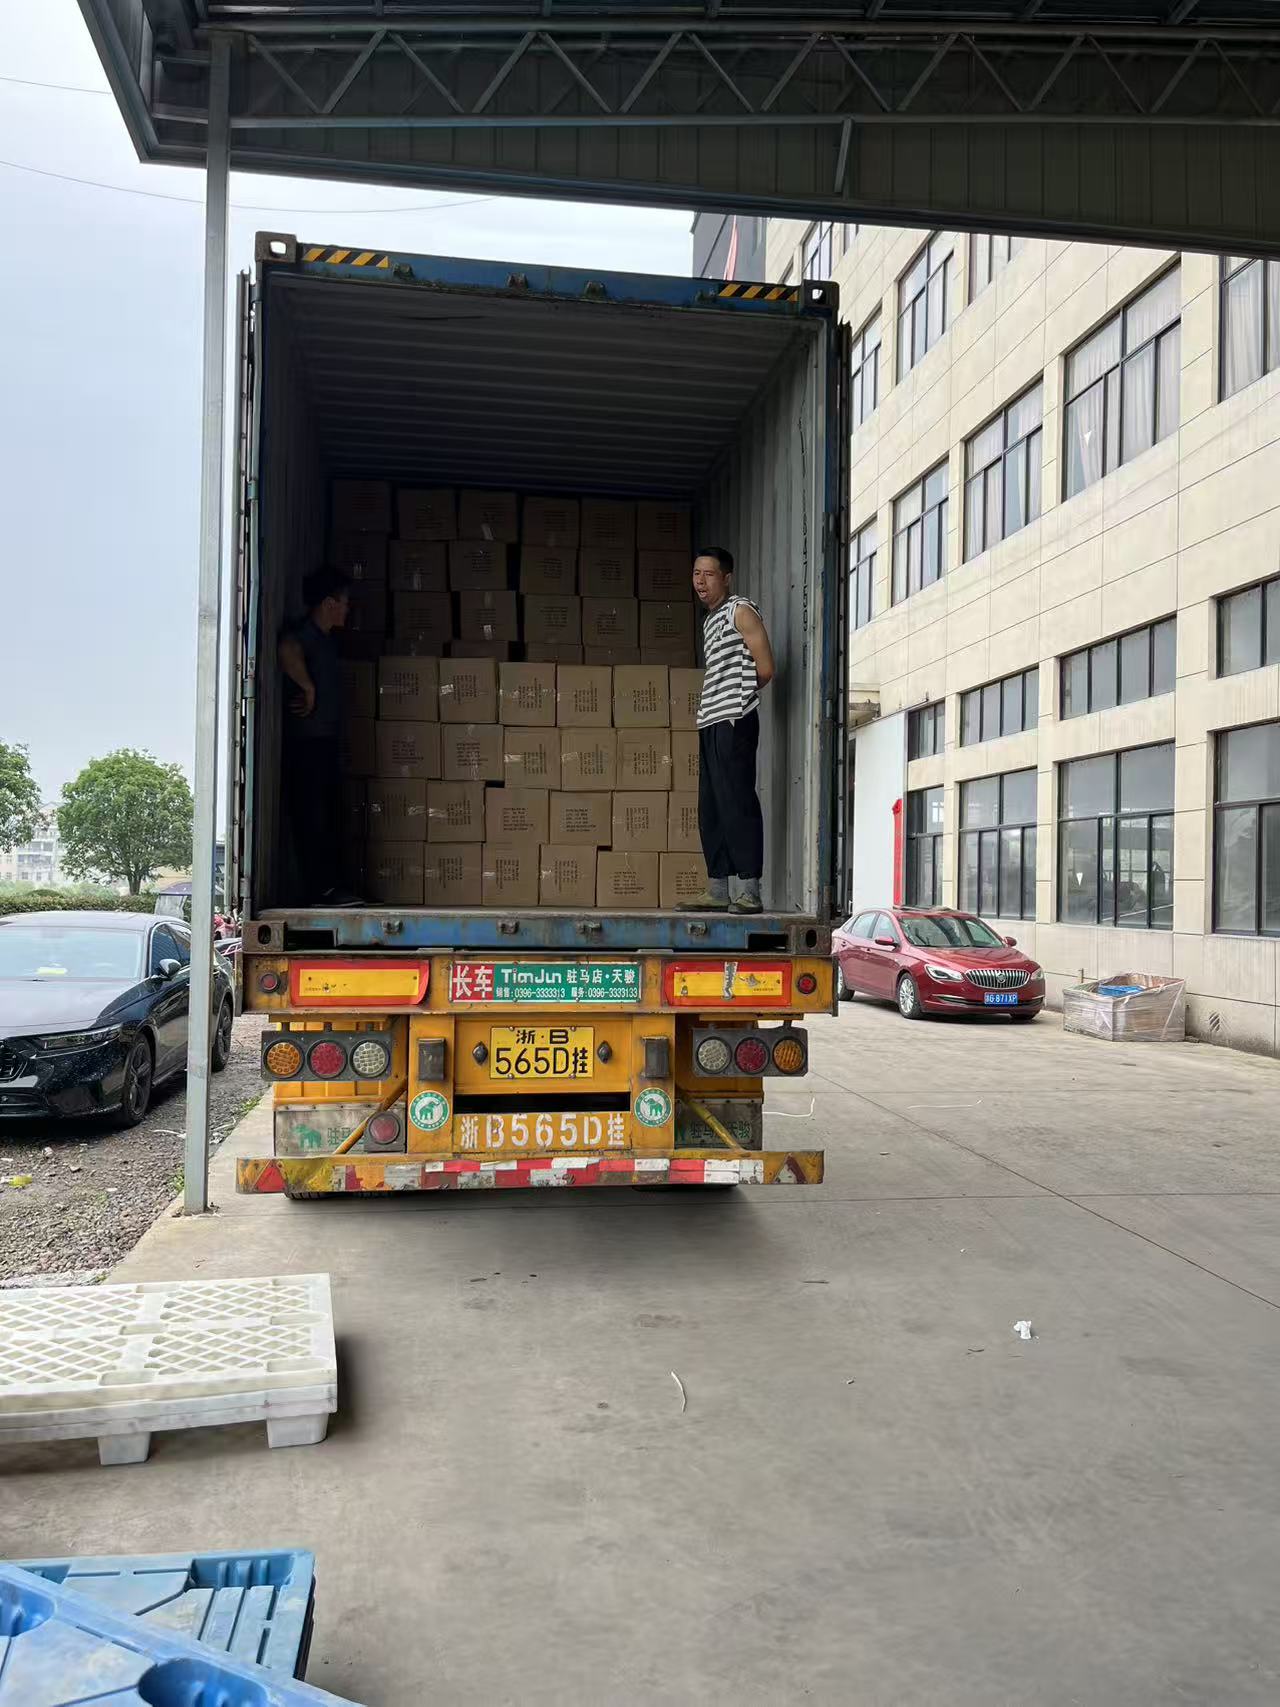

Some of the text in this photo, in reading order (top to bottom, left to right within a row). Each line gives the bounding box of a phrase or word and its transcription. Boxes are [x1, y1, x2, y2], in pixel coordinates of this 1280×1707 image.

[452, 965, 493, 999] 长车
[495, 1047, 588, 1074] 565D挂
[460, 1112, 625, 1149] 浙B565D挂
